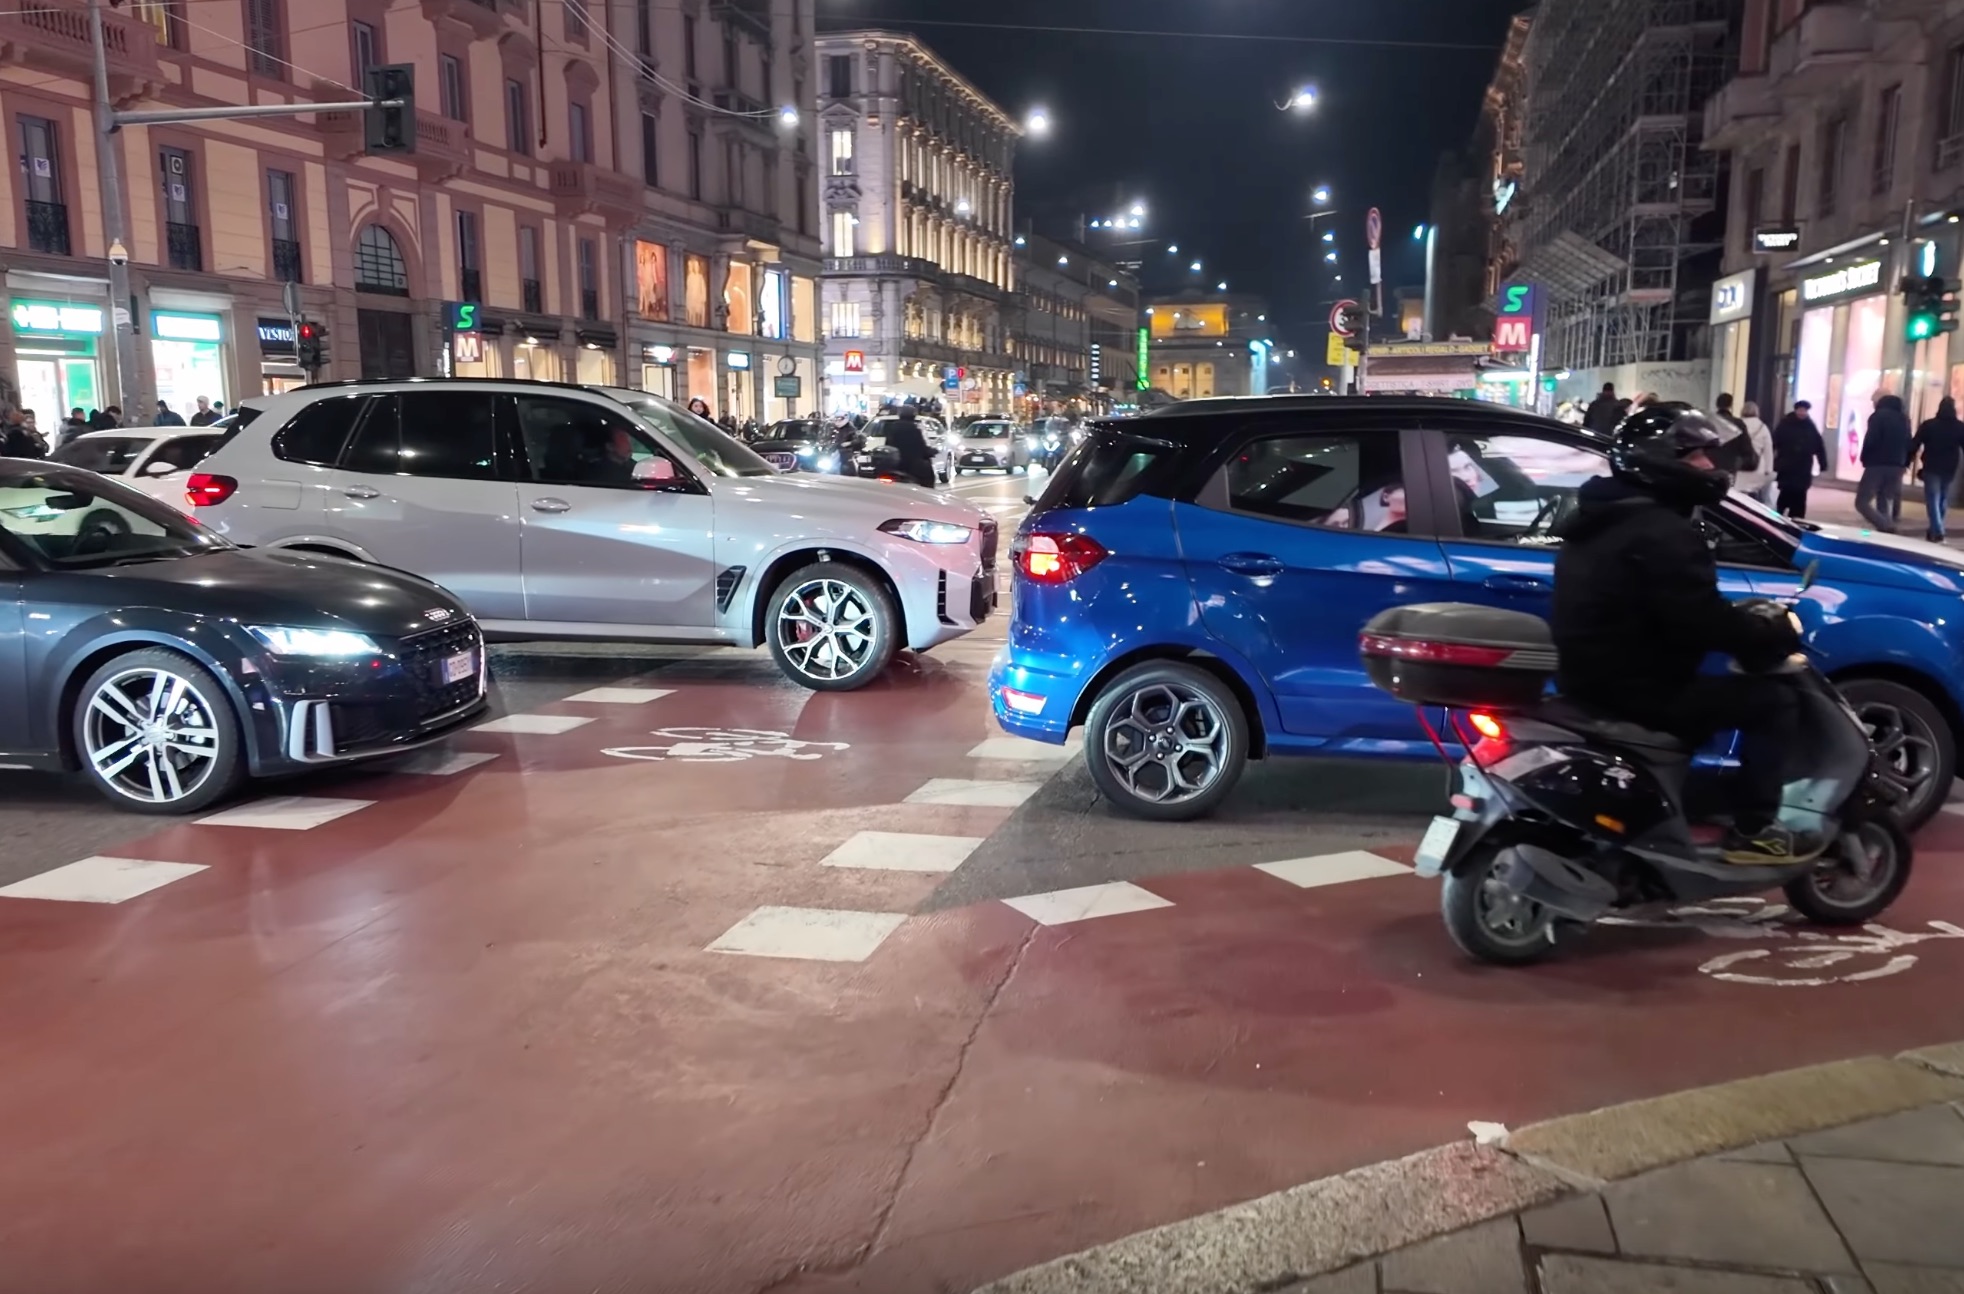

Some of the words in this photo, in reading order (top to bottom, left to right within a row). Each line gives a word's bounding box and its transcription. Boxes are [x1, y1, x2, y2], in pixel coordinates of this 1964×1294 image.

[1503, 286, 1529, 312] S
[457, 305, 475, 328] S
[1498, 322, 1527, 345] M
[456, 335, 480, 357] M
[846, 354, 862, 368] M
